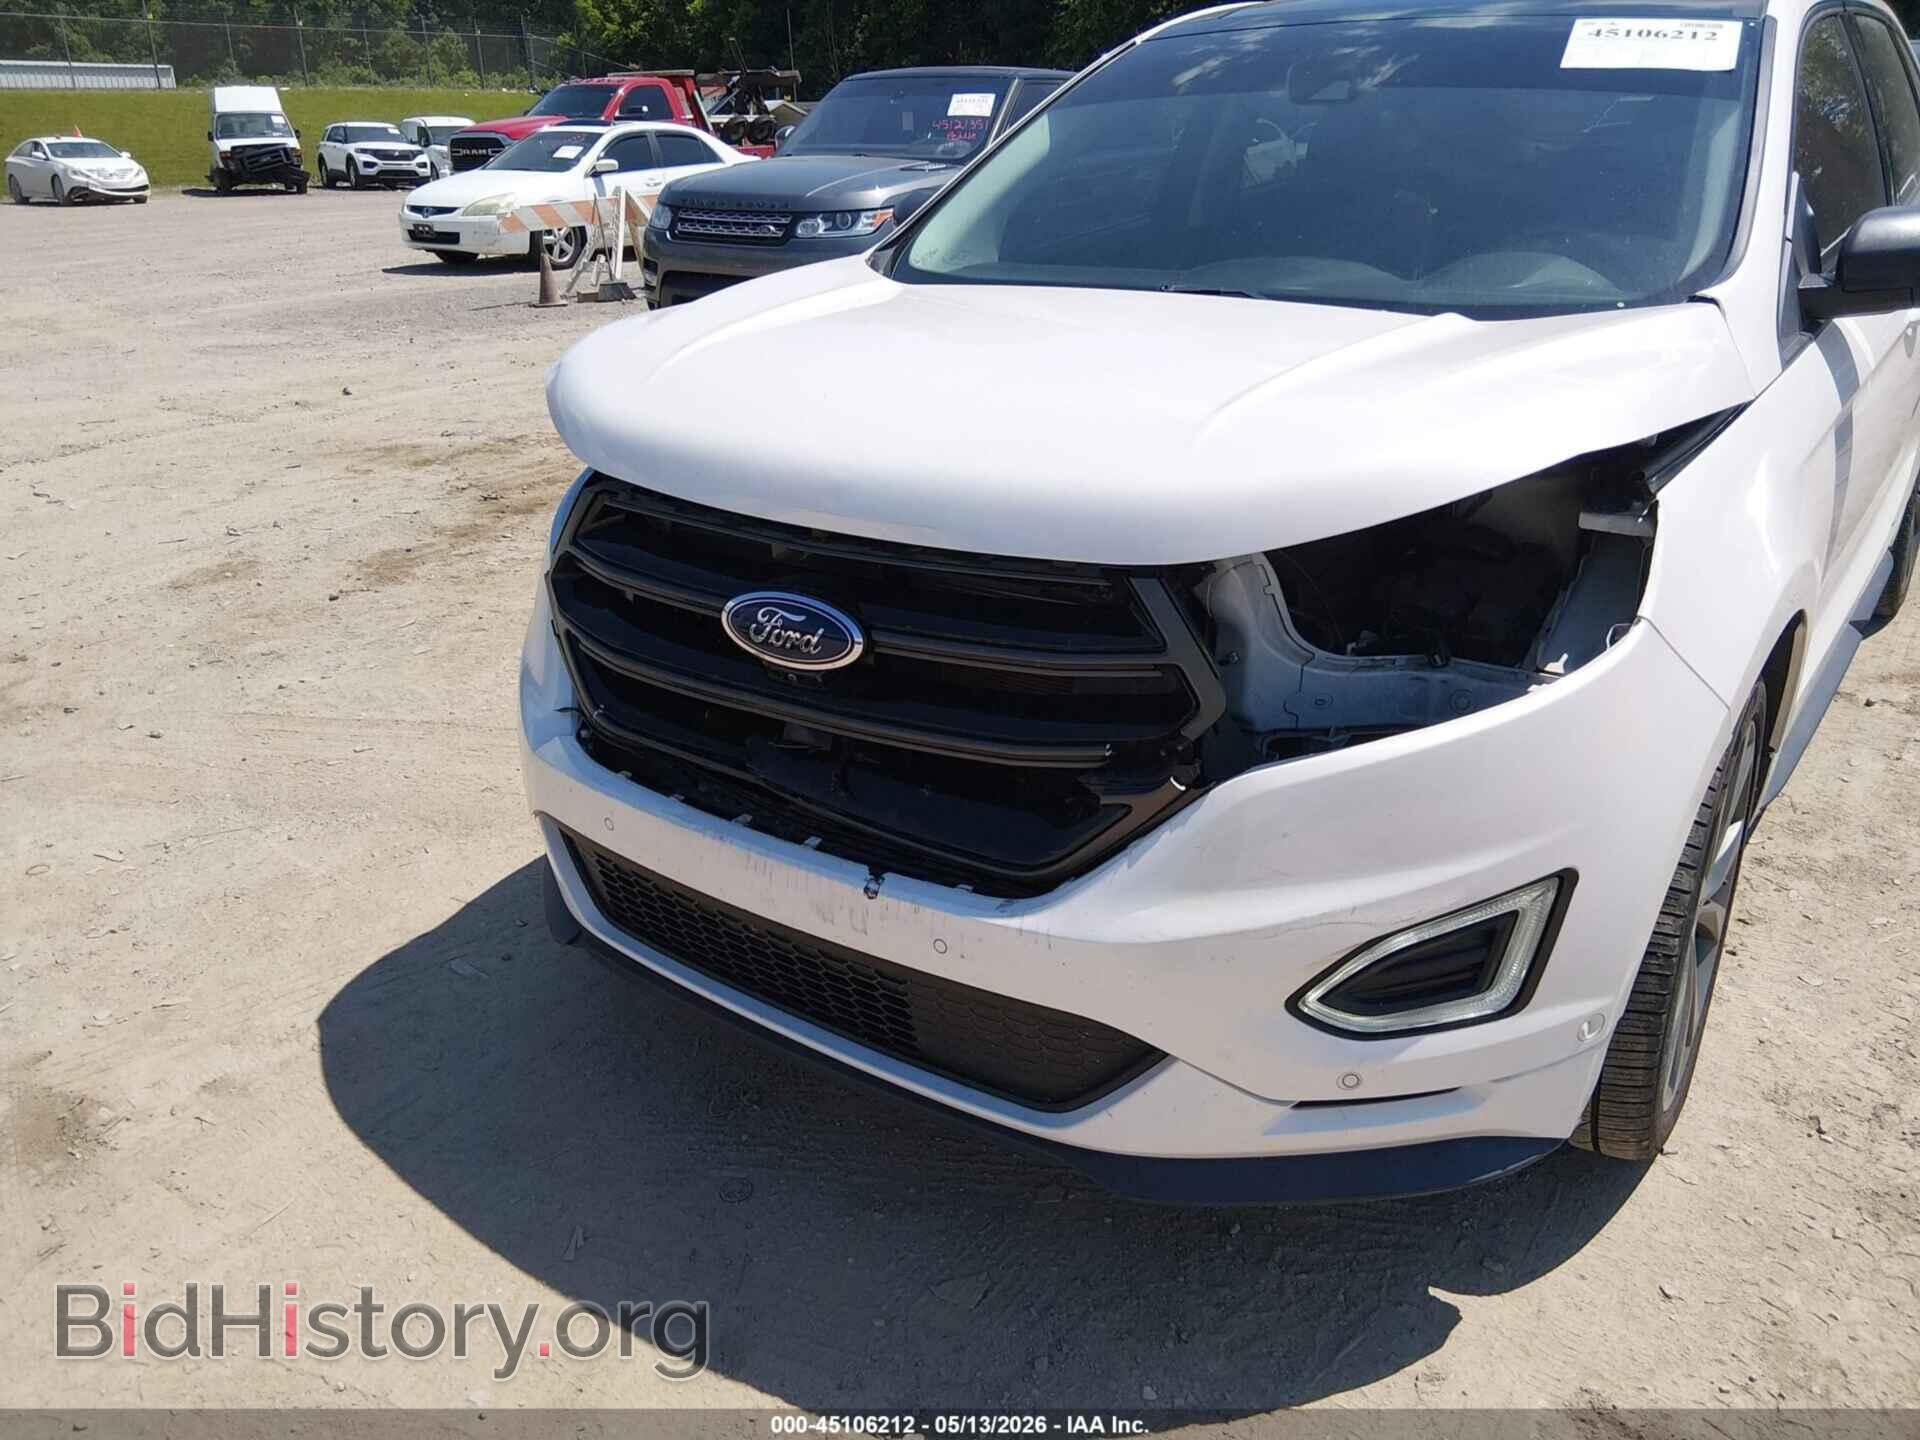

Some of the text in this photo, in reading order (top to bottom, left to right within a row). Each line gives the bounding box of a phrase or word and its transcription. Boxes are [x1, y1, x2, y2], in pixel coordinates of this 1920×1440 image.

[1588, 28, 1718, 41] 45106212
[463, 148, 488, 156] RAM
[749, 606, 825, 654] Ford
